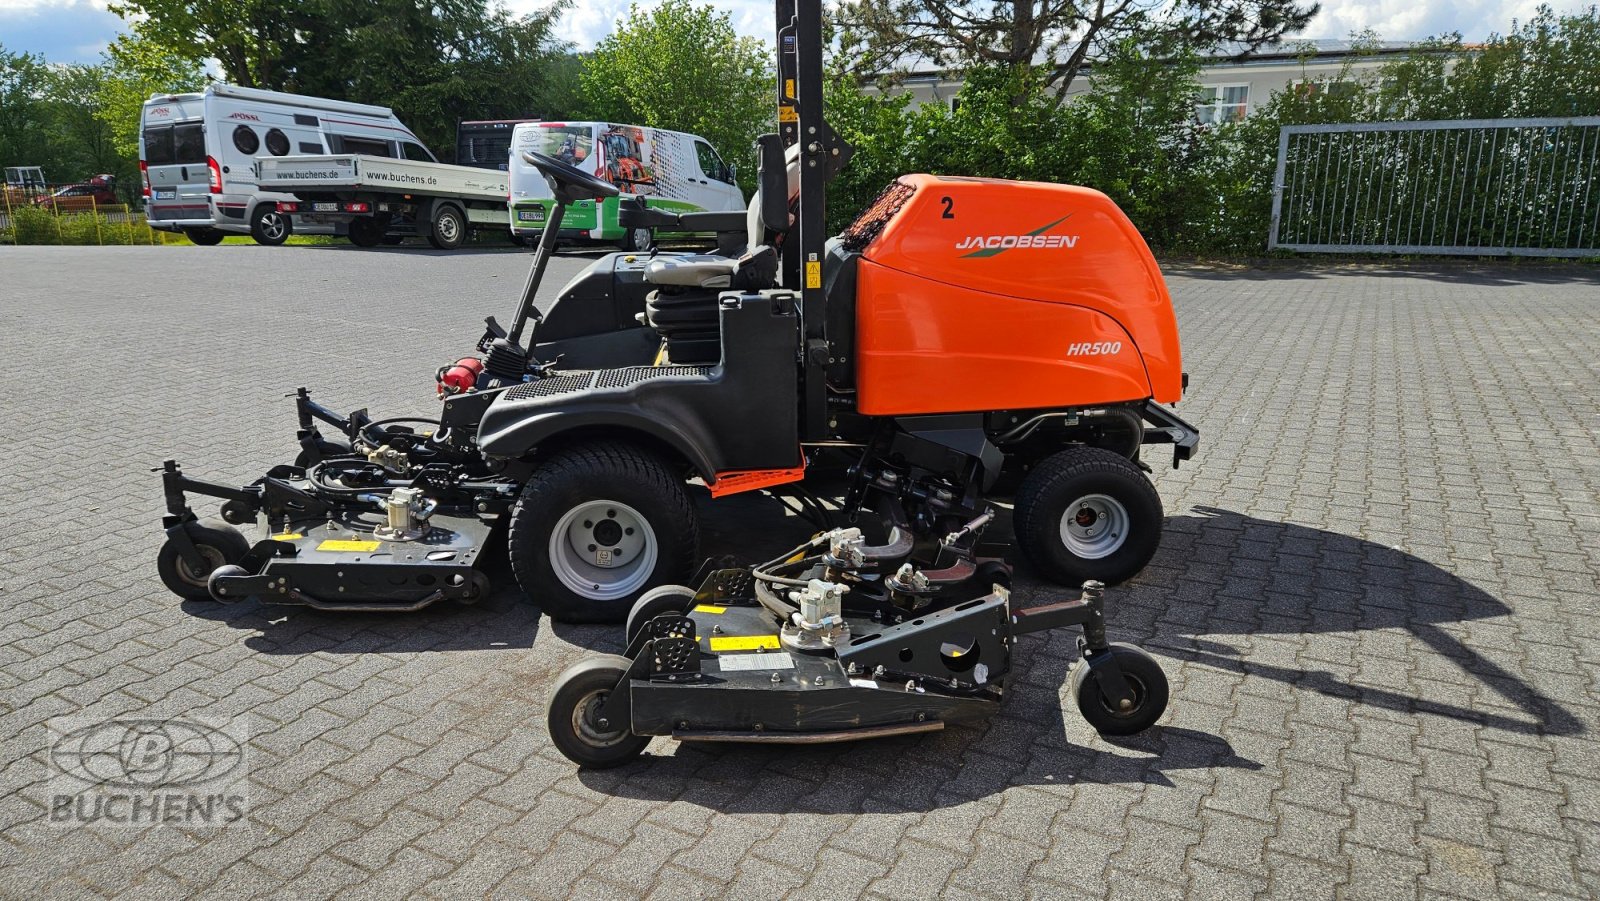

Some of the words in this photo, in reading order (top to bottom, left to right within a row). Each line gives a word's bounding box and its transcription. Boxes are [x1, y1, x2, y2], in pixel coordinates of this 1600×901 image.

[276, 170, 339, 179] www.buchens.de
[366, 170, 437, 185] www.buchens.de
[941, 196, 955, 219] 2
[955, 235, 1077, 249] JACOBSEN
[1067, 341, 1121, 356] HR500
